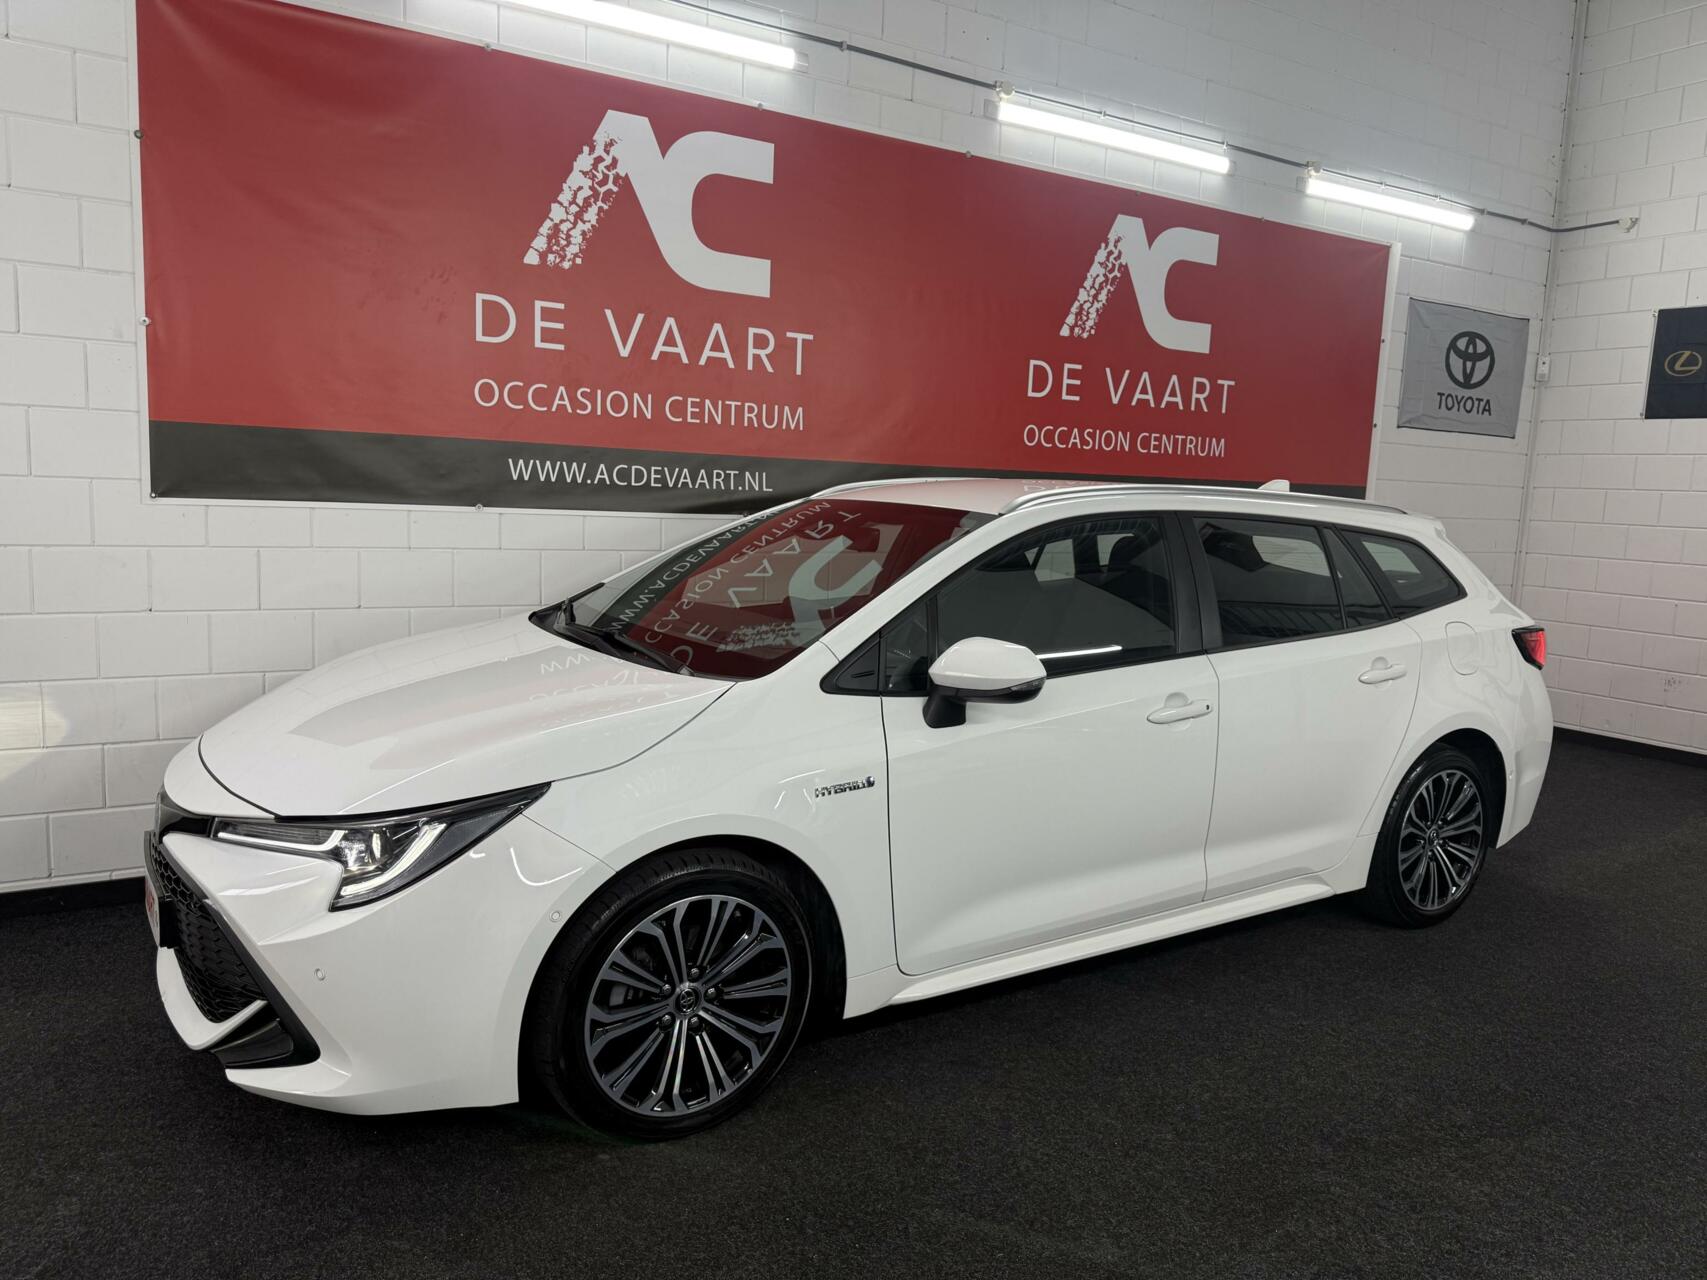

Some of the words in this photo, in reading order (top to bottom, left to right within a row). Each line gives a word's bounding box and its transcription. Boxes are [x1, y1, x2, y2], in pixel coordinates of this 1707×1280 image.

[475, 292, 565, 351] DE
[604, 308, 814, 376] VAART
[1027, 359, 1083, 401] DE
[1105, 367, 1236, 414] VAART
[1436, 391, 1492, 416] TOYOTA
[474, 378, 652, 420] OCCASION
[664, 395, 804, 431] CENTRUM
[1023, 424, 1130, 452] OCCASION
[1136, 432, 1226, 458] CENTRUM
[508, 458, 773, 492] WWW.ACDEVAART.NL
[815, 780, 866, 798] HYBRID
